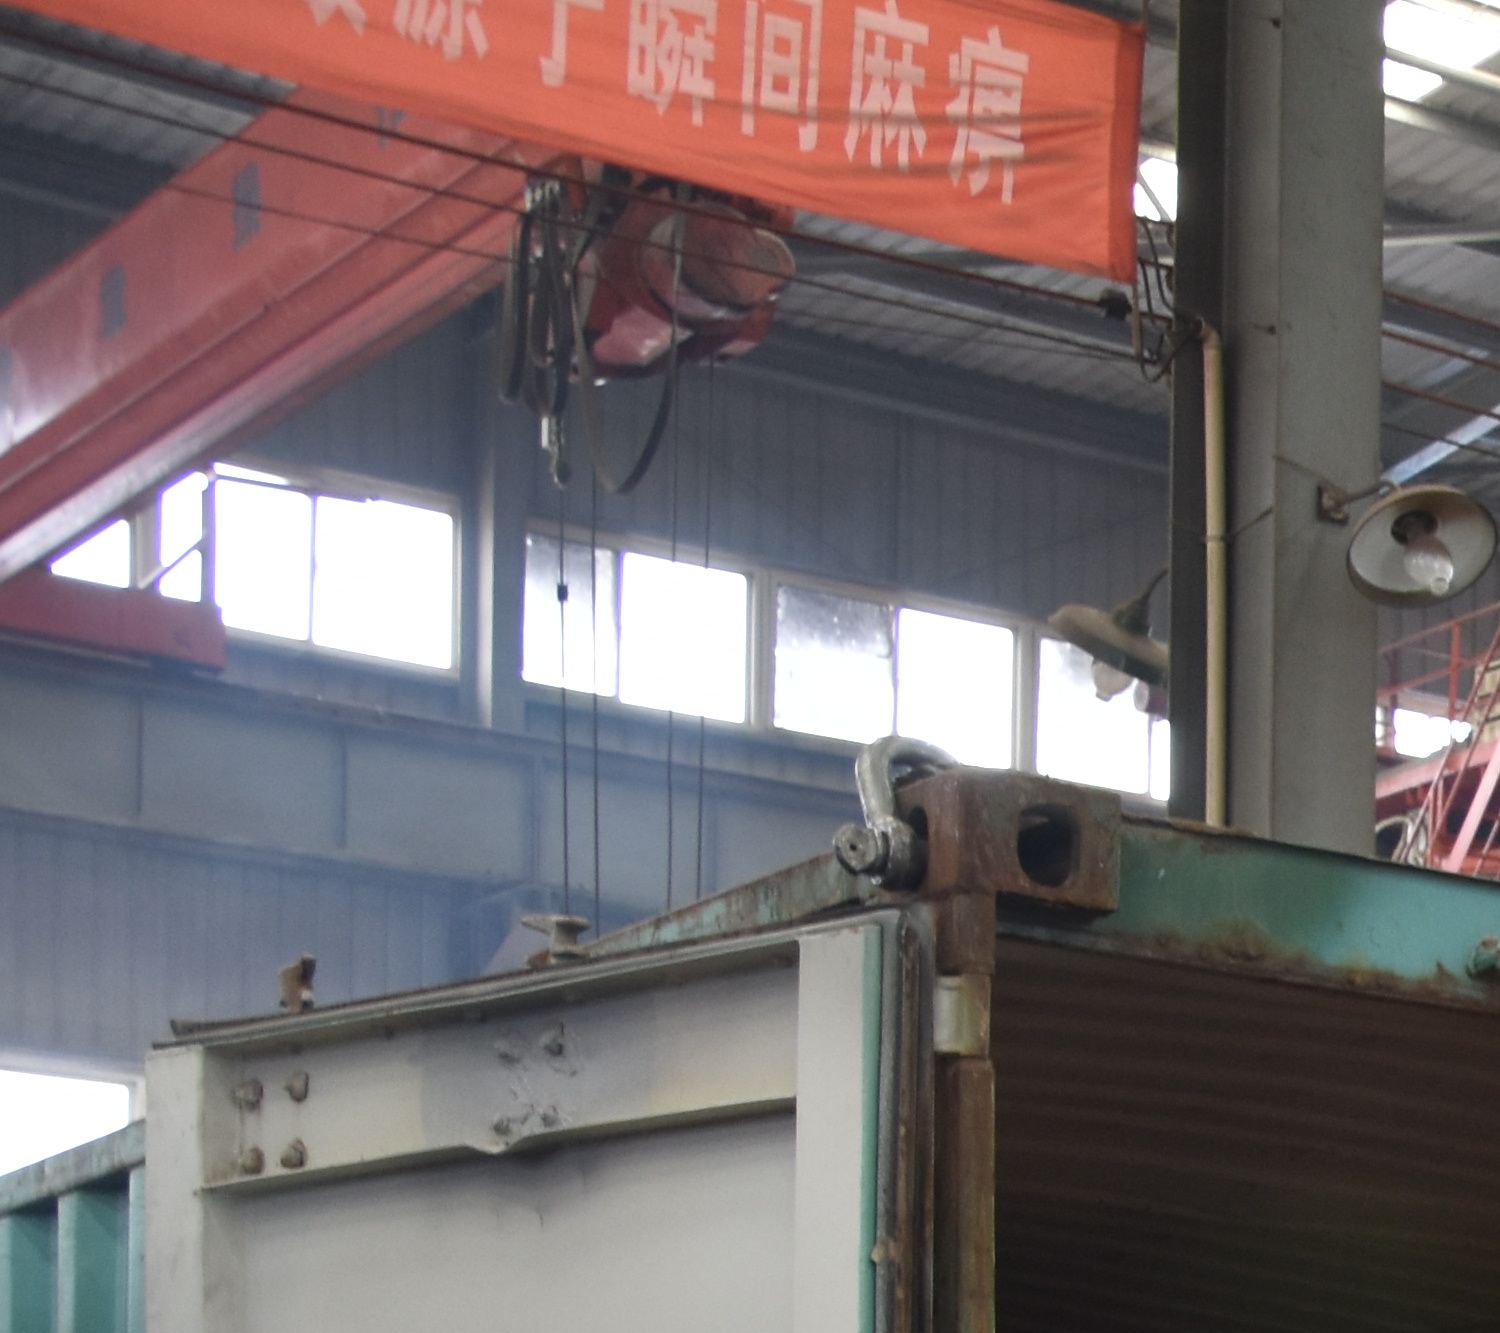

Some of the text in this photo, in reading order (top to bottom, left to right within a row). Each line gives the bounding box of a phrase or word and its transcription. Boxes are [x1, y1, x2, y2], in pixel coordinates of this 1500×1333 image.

[307, 0, 1030, 204] 于瞬间麻痹
